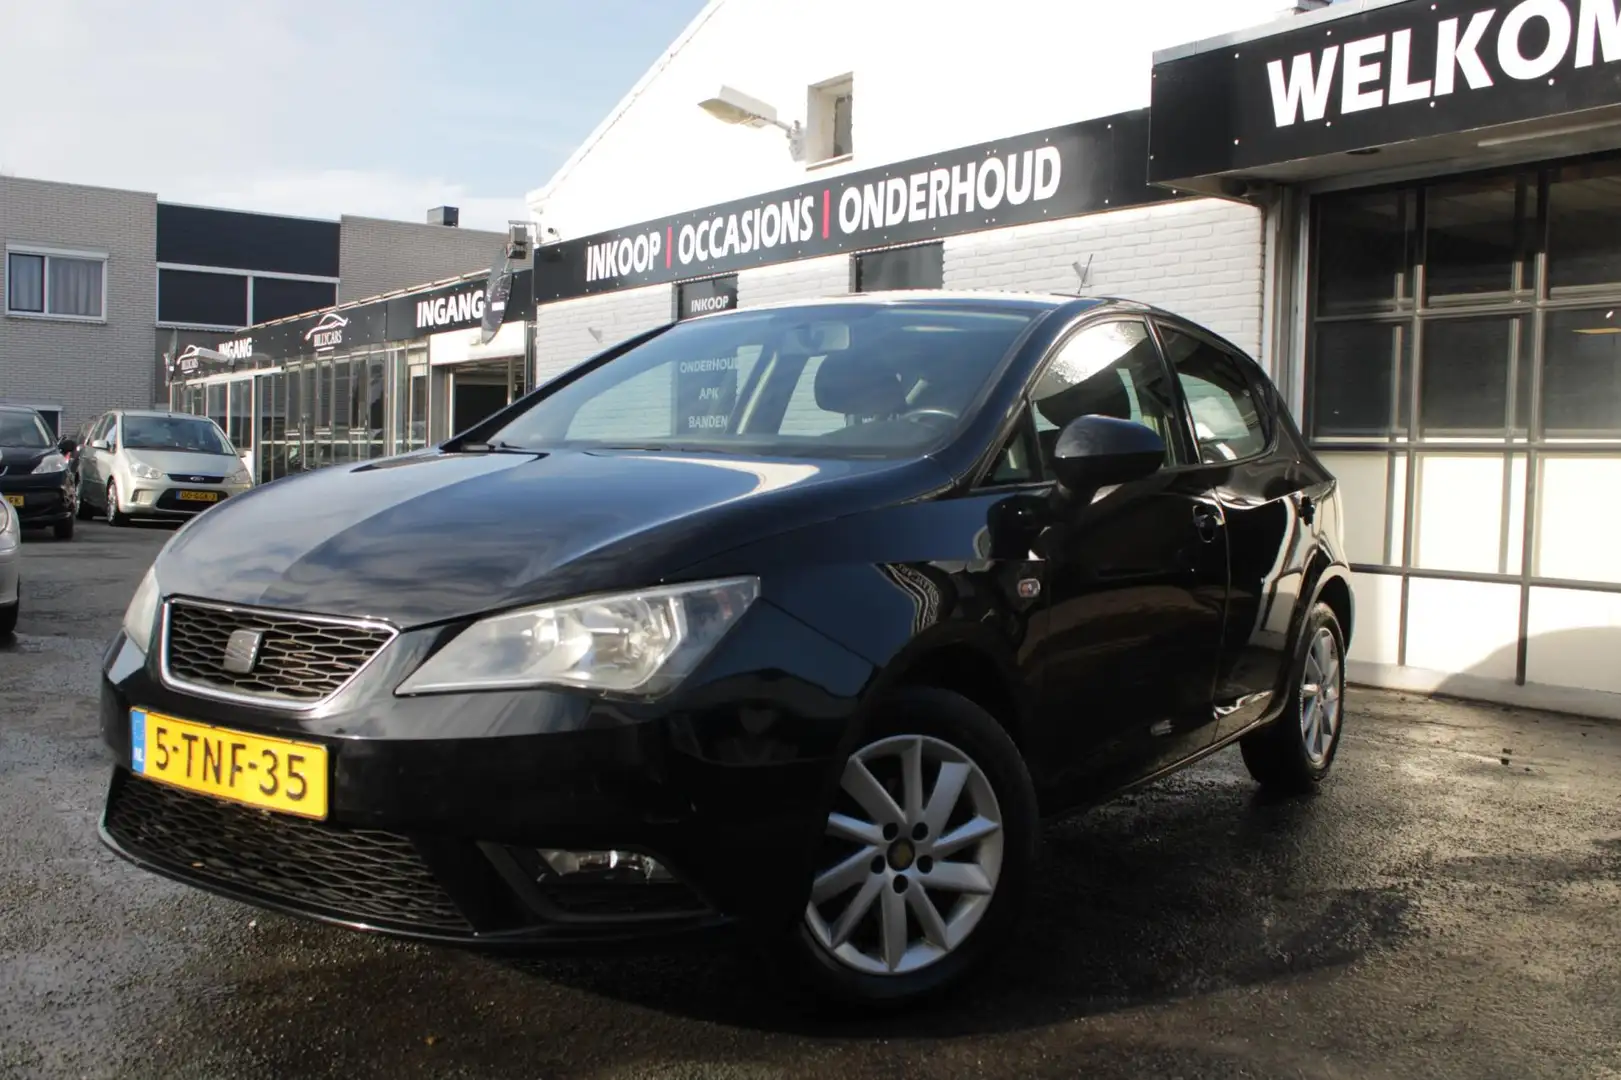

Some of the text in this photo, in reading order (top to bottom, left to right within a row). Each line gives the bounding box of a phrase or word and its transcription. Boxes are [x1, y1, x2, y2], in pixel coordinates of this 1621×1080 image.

[585, 146, 1060, 282] INKOOP OCCASIONS ONDERHOUD
[416, 290, 485, 328] INGANG
[690, 295, 729, 313] INKOOP
[698, 387, 719, 400] APK
[688, 414, 728, 429] BANDEN
[155, 727, 308, 801] 5-TNF-35
